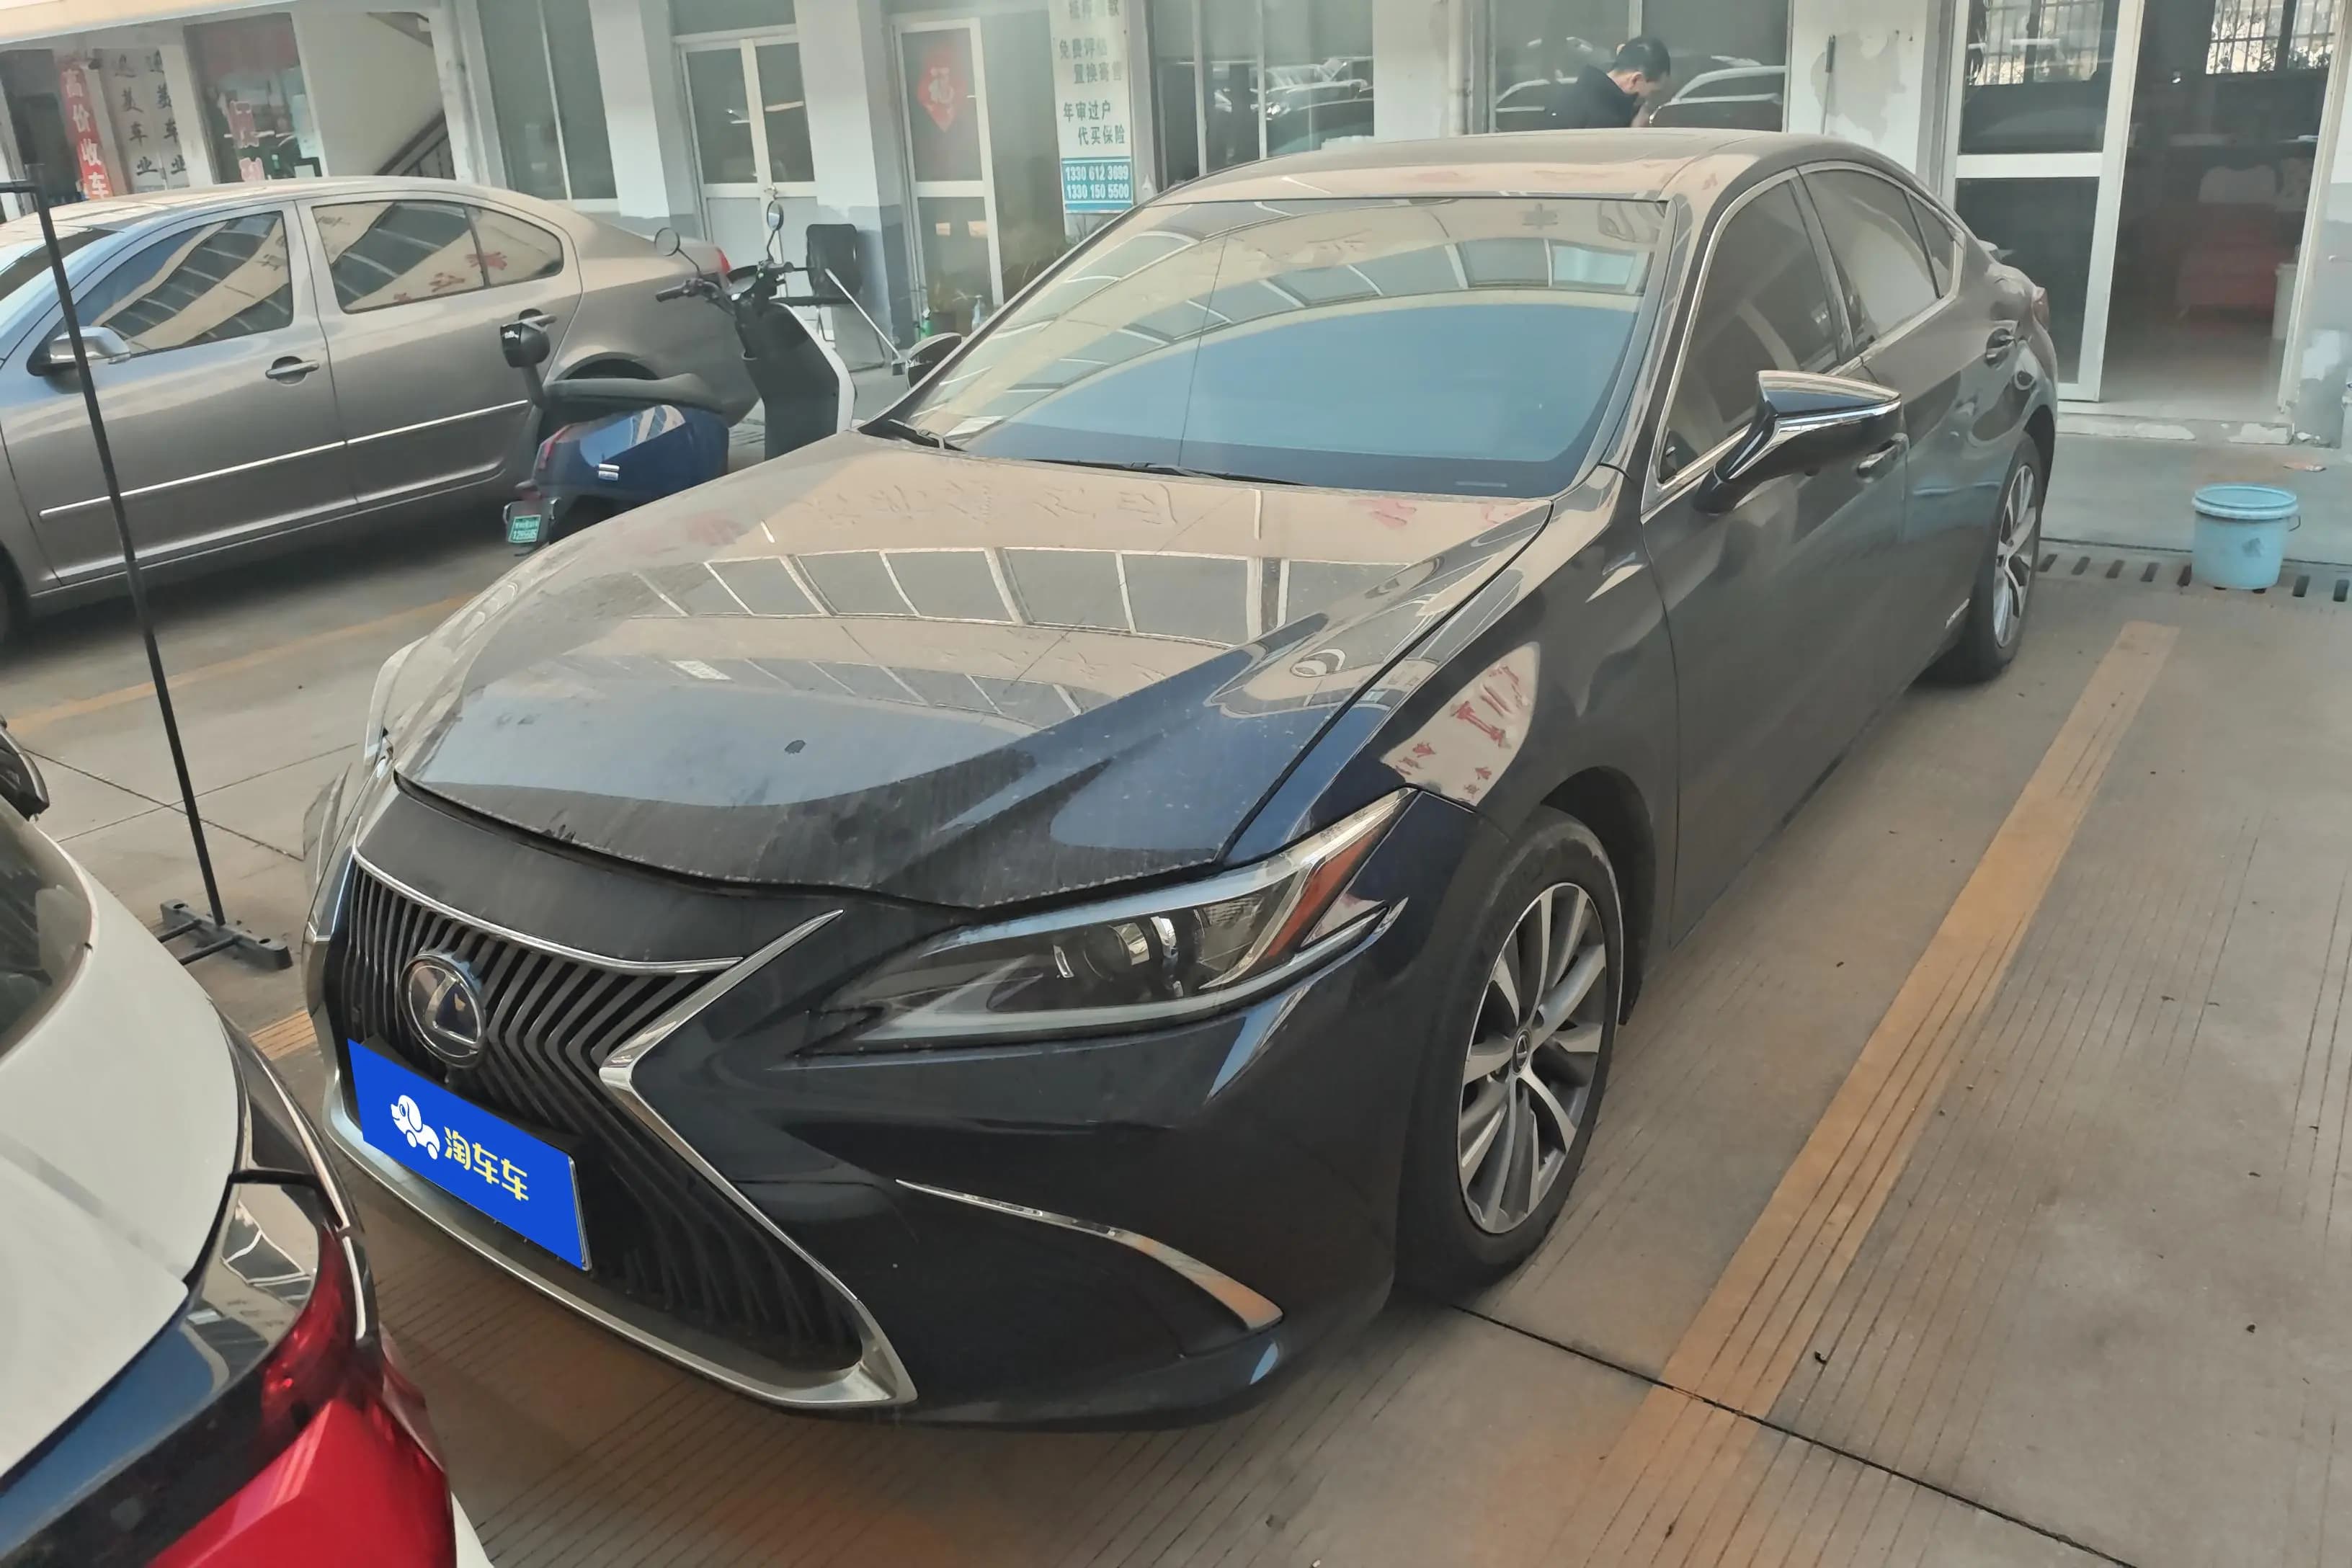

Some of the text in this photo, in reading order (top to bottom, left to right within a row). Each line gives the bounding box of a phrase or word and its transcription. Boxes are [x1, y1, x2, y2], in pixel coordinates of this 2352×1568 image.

[1063, 99, 1111, 122] 年审过户
[65, 68, 109, 198] 高价收车
[1078, 125, 1126, 146] 代买保险
[1065, 166, 1087, 182] 1330
[1089, 164, 1105, 181] 612
[1066, 183, 1129, 199] 1330 150 5500
